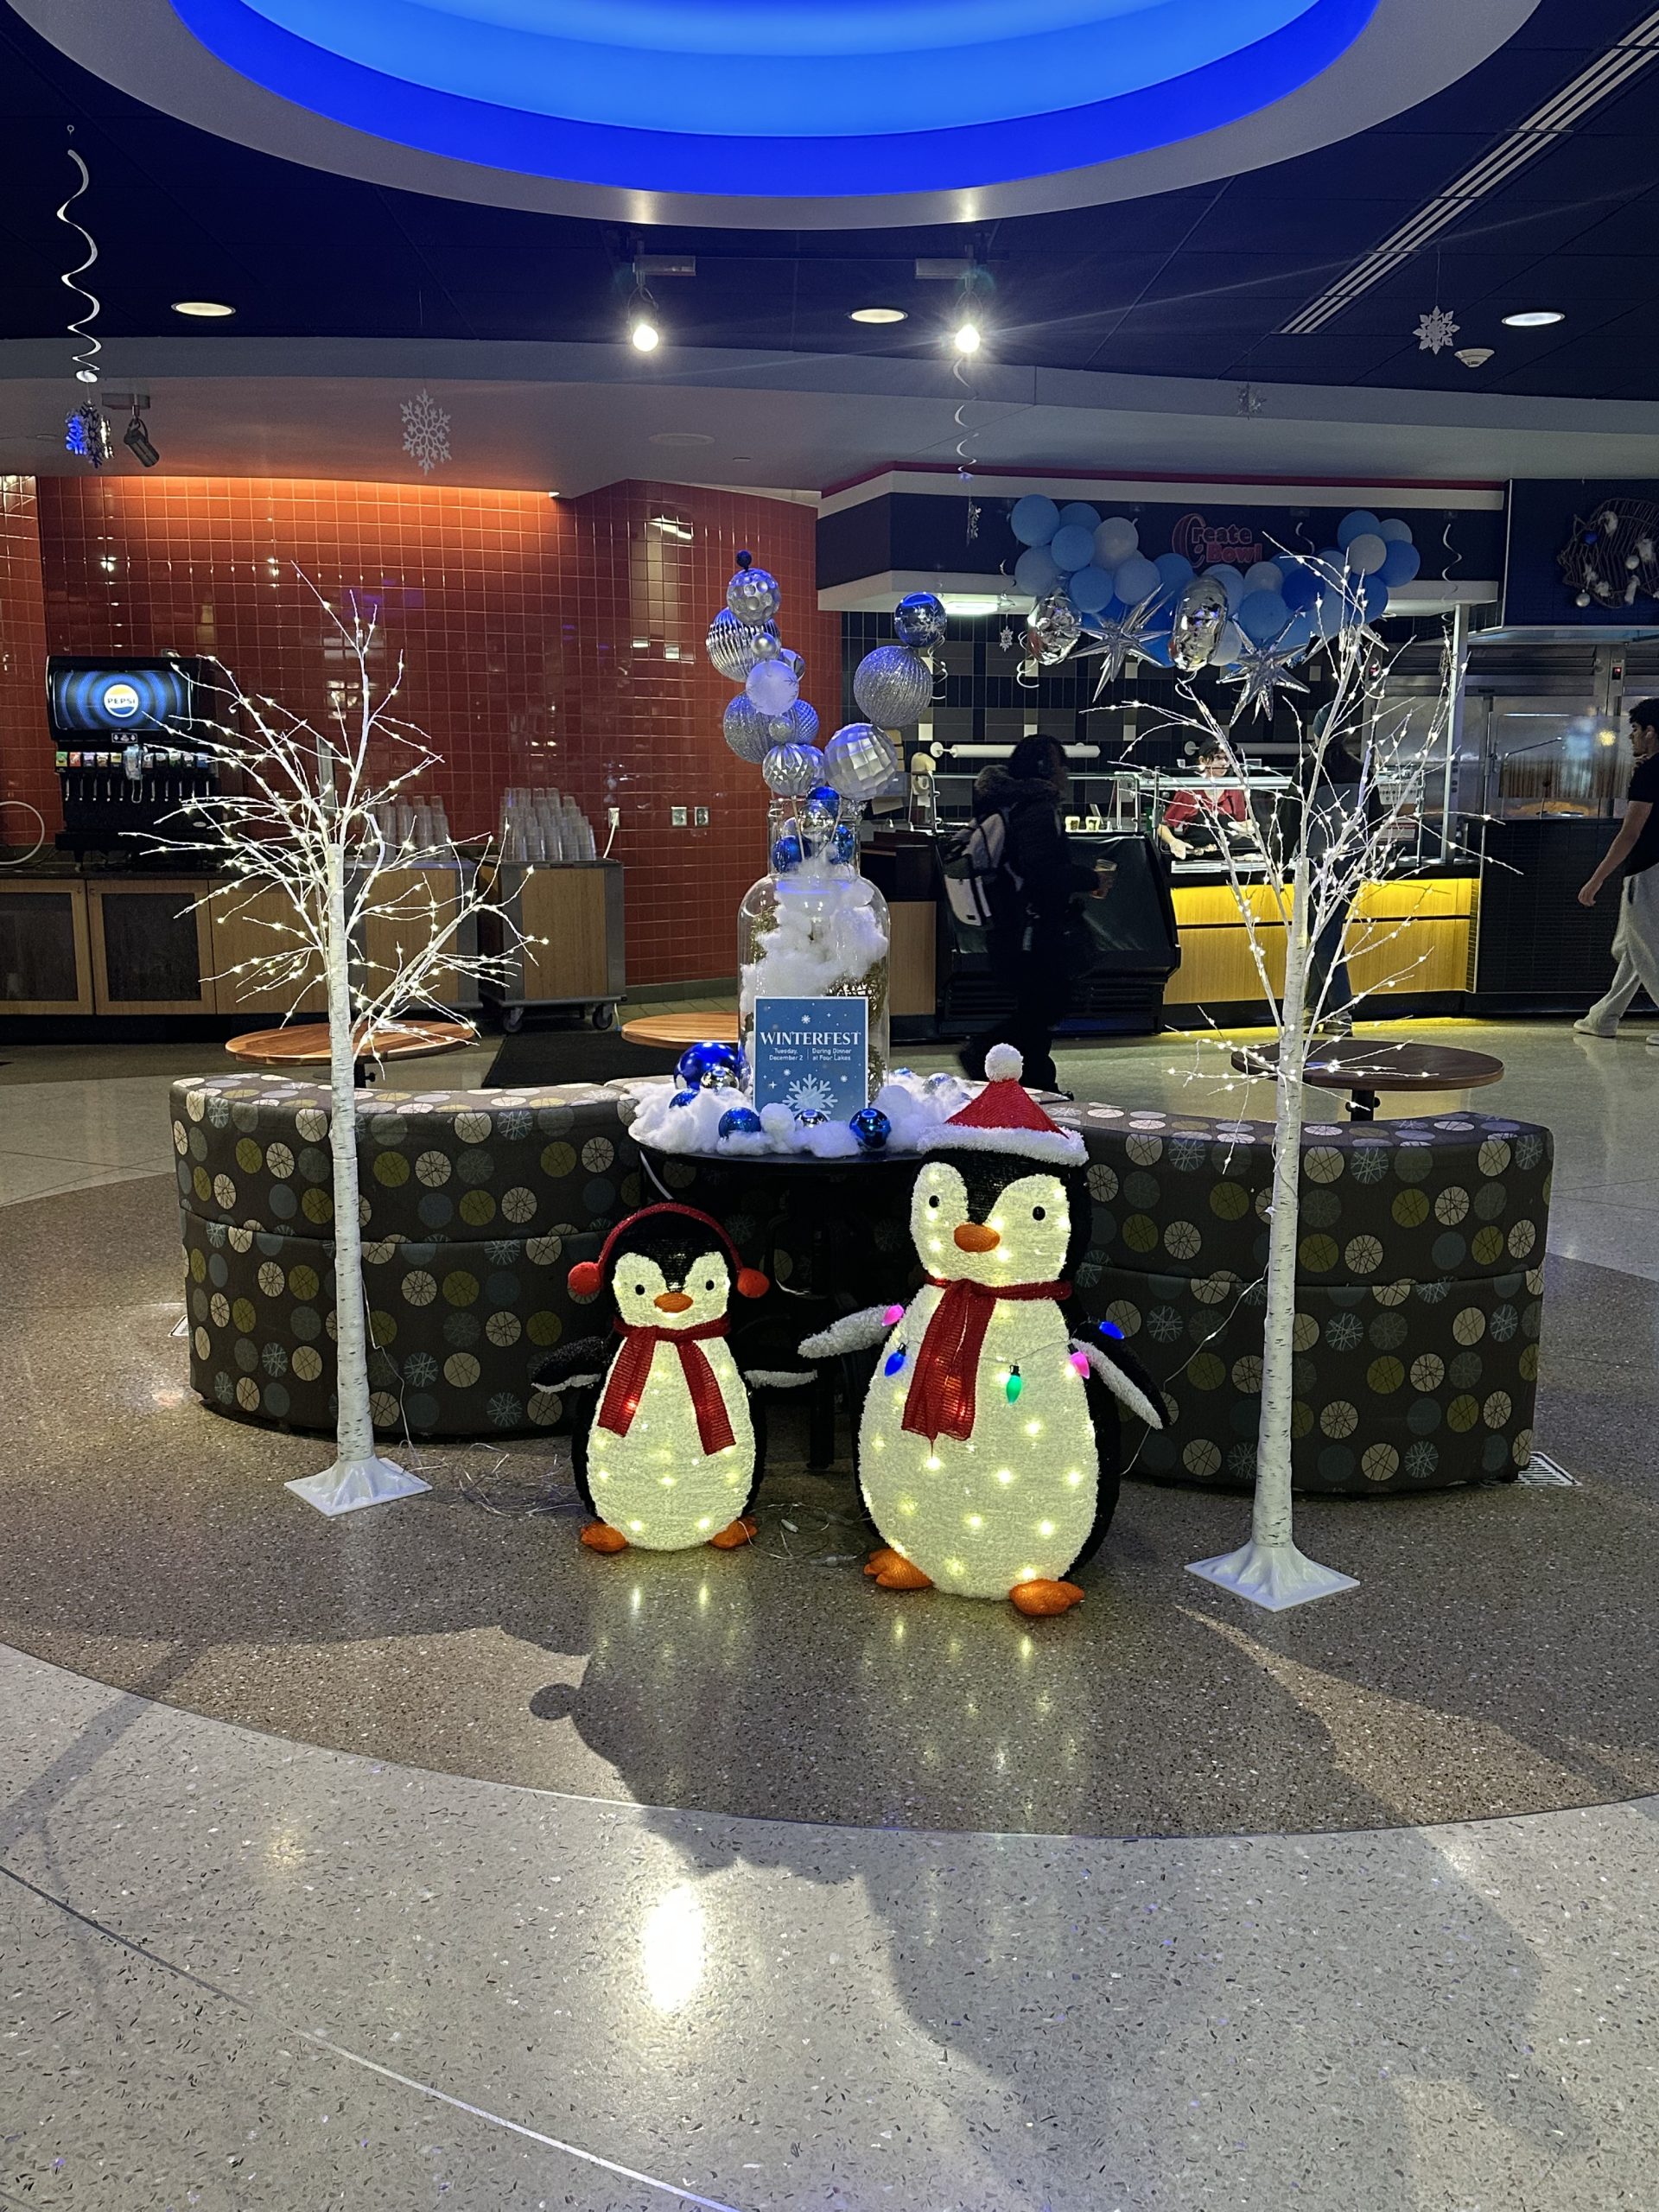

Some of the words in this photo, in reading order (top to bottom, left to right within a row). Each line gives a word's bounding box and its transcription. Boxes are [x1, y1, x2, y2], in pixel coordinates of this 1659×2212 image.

[1172, 513, 1252, 568] Create
[1206, 541, 1262, 563] Bowl
[760, 1032, 861, 1045] WINTERFEST
